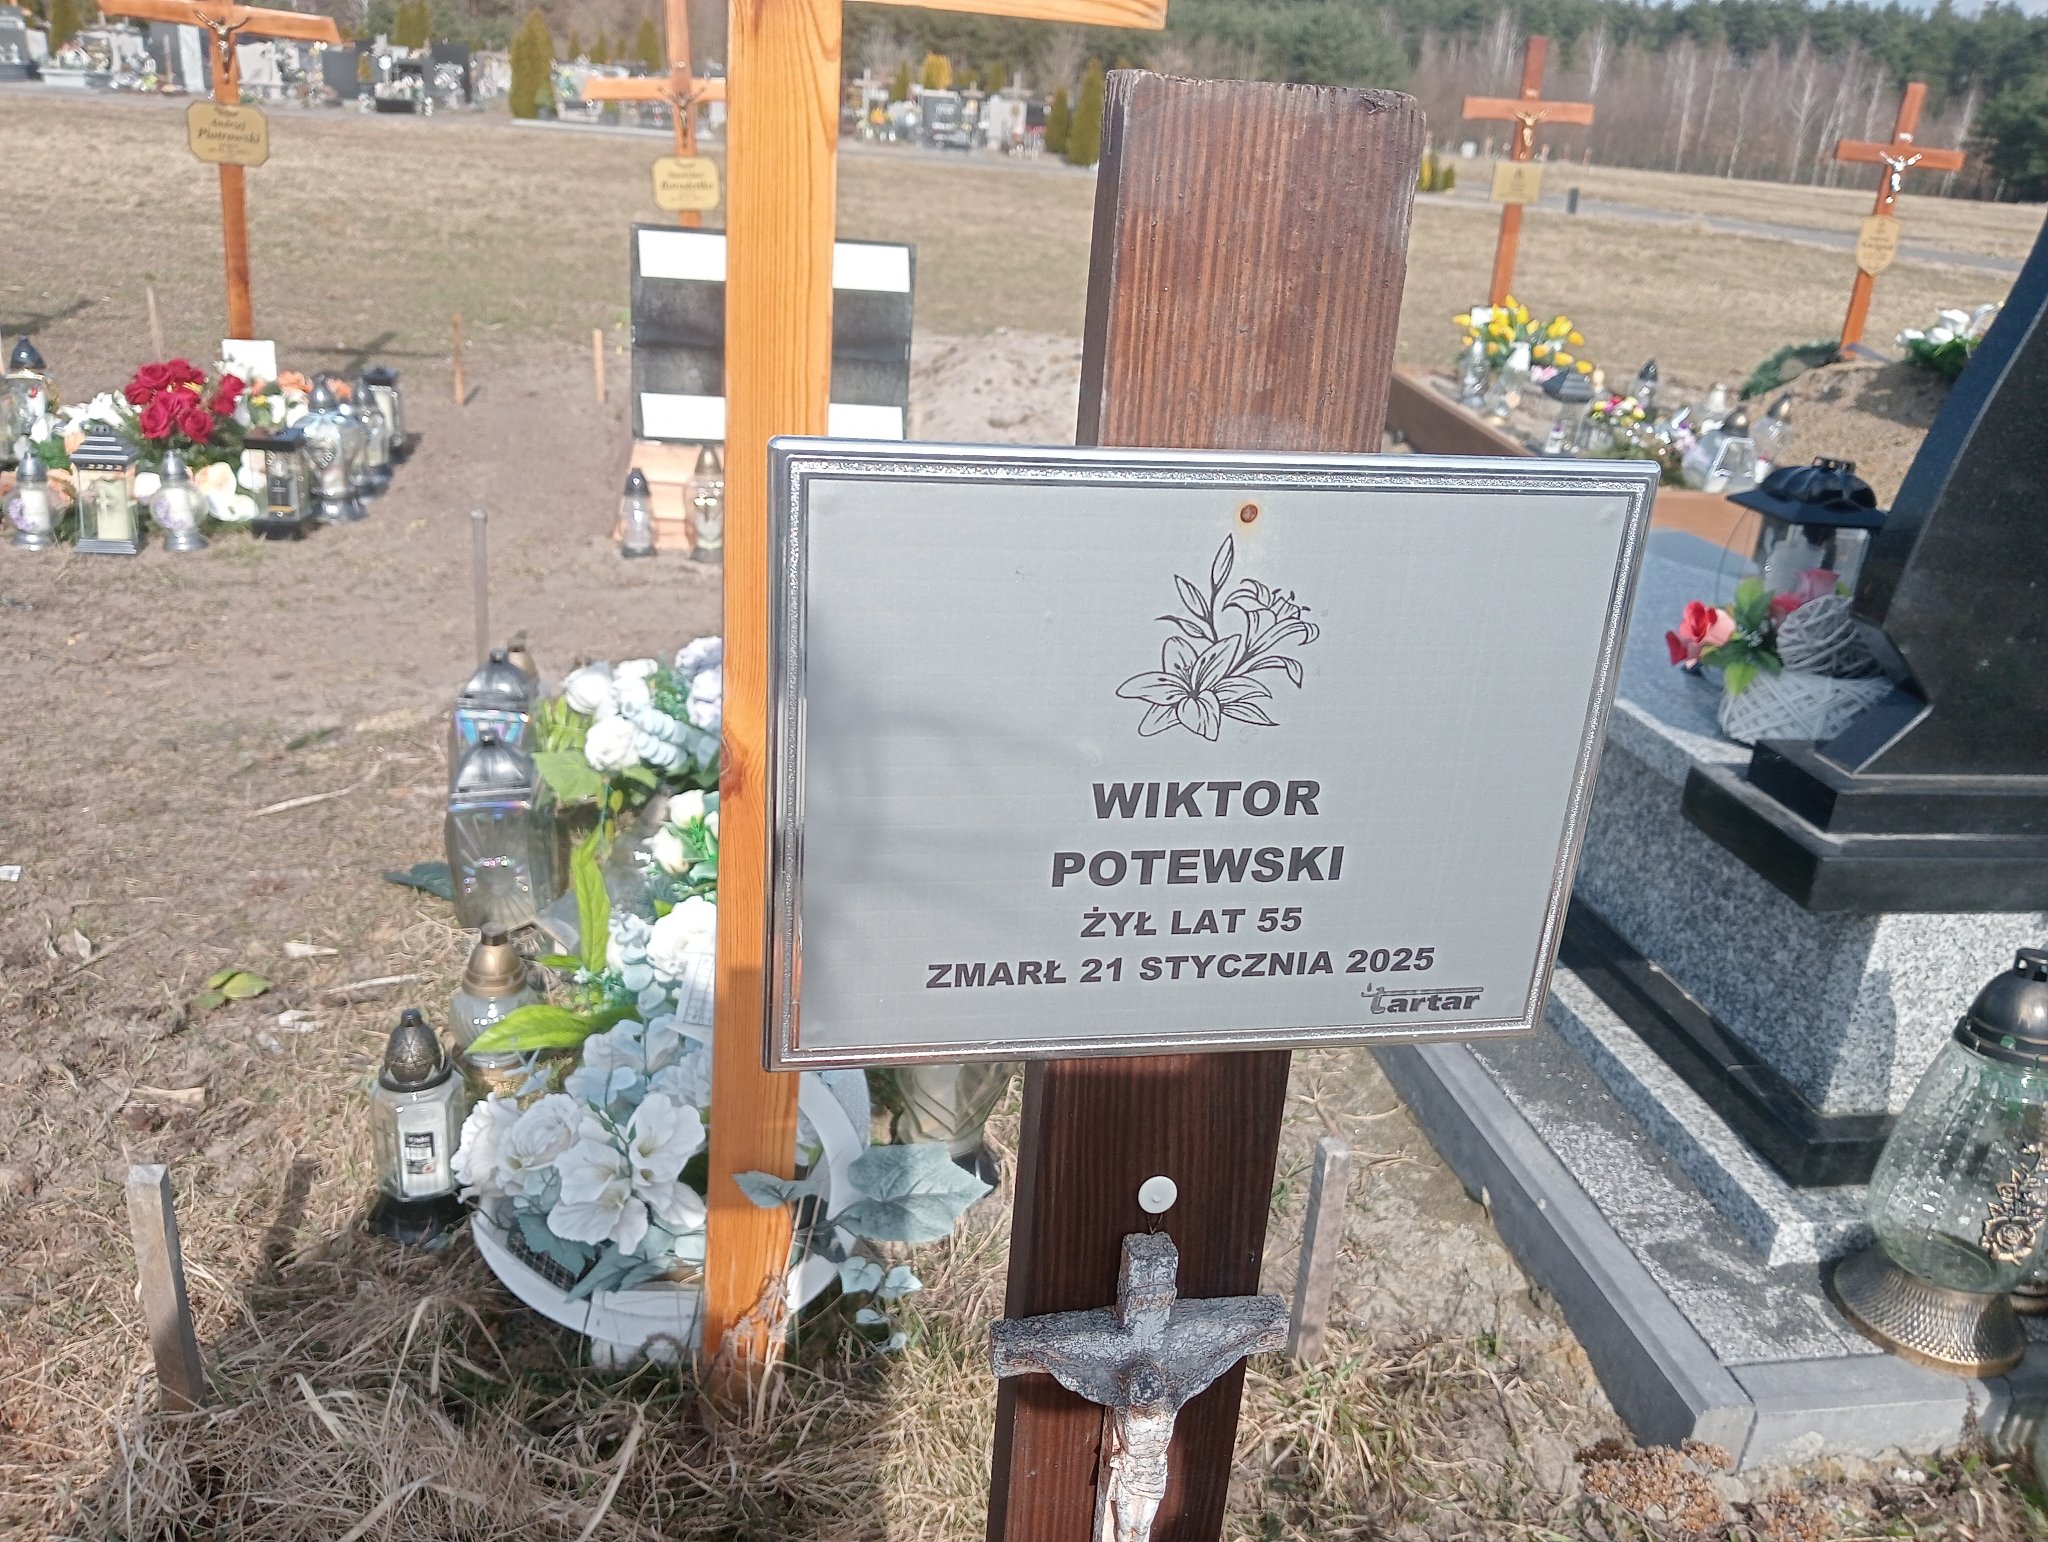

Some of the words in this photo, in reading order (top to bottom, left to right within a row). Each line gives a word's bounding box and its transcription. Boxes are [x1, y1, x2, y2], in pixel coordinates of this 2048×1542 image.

[197, 127, 261, 144] Piotrowski
[1092, 780, 1321, 819] WIKTOR
[1051, 846, 1345, 887] POTEWSKI
[1080, 906, 1157, 938] ŻYŁ
[1170, 909, 1247, 935] LAT
[1256, 907, 1303, 933] 55
[925, 960, 1067, 989] ZMARŁ
[1079, 957, 1123, 983] 21
[1139, 951, 1334, 981] STYCZNIA
[1345, 946, 1436, 974] 2025
[1361, 984, 1485, 1014] tartar
